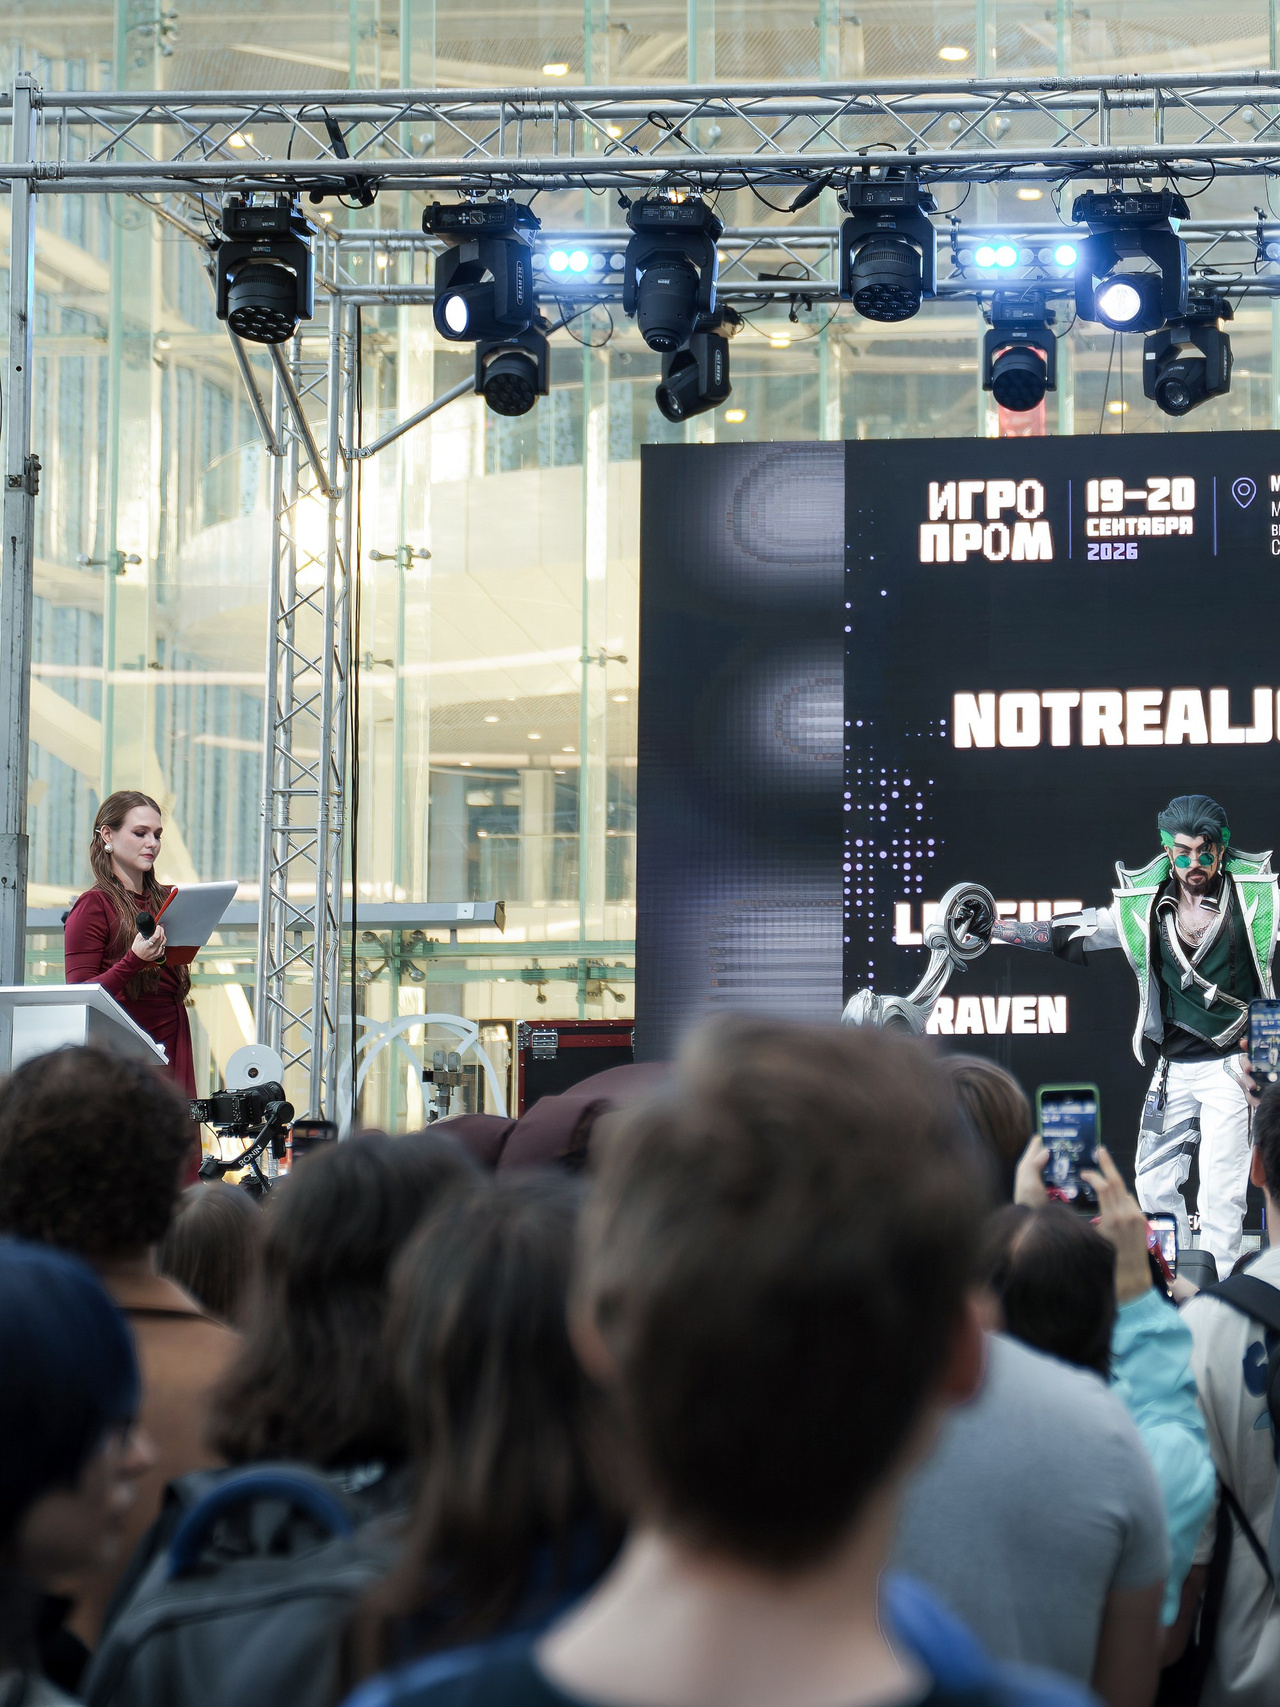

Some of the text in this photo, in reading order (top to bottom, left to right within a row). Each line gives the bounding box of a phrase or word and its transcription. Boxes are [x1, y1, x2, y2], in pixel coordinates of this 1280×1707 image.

[928, 478, 1044, 521] ИГРО
[1086, 477, 1195, 512] 19–20
[920, 521, 1053, 562] ПРОМ
[1086, 516, 1194, 536] СЕНТЯБРЯ
[1087, 543, 1138, 561] 2026
[926, 995, 1067, 1035] RAVEN
[237, 1144, 263, 1167] RONIN
